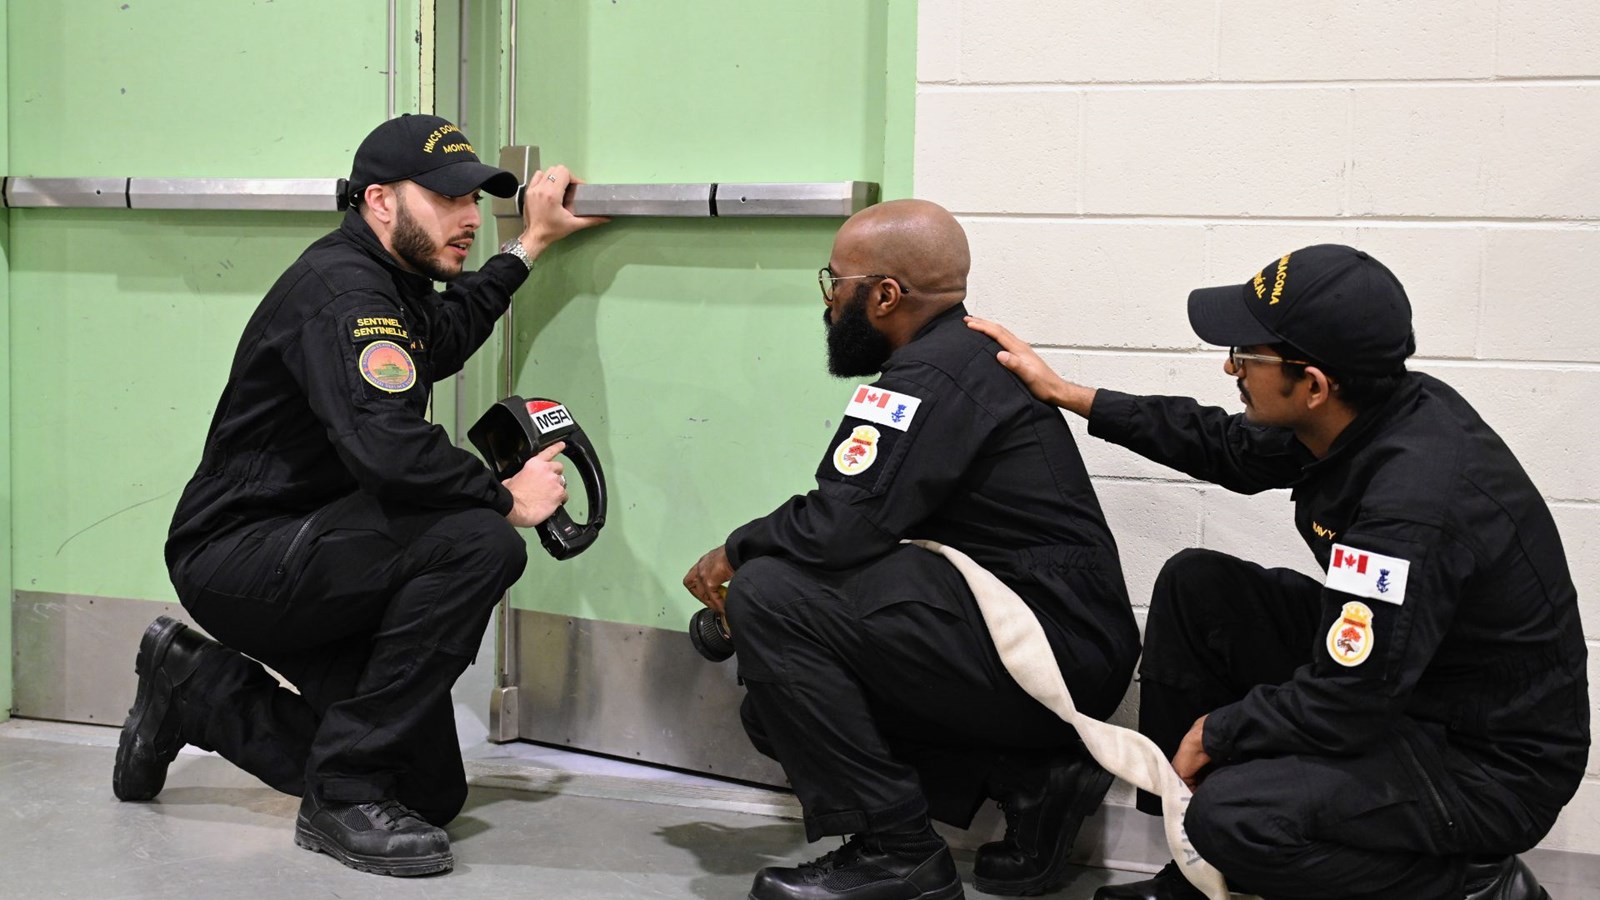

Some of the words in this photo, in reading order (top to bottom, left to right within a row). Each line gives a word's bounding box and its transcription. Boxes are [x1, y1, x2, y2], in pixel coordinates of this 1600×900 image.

[423, 130, 442, 154] HMCS
[357, 317, 402, 328] SENTINEL
[353, 326, 409, 339] SENTINELLE
[535, 408, 571, 430] MSA
